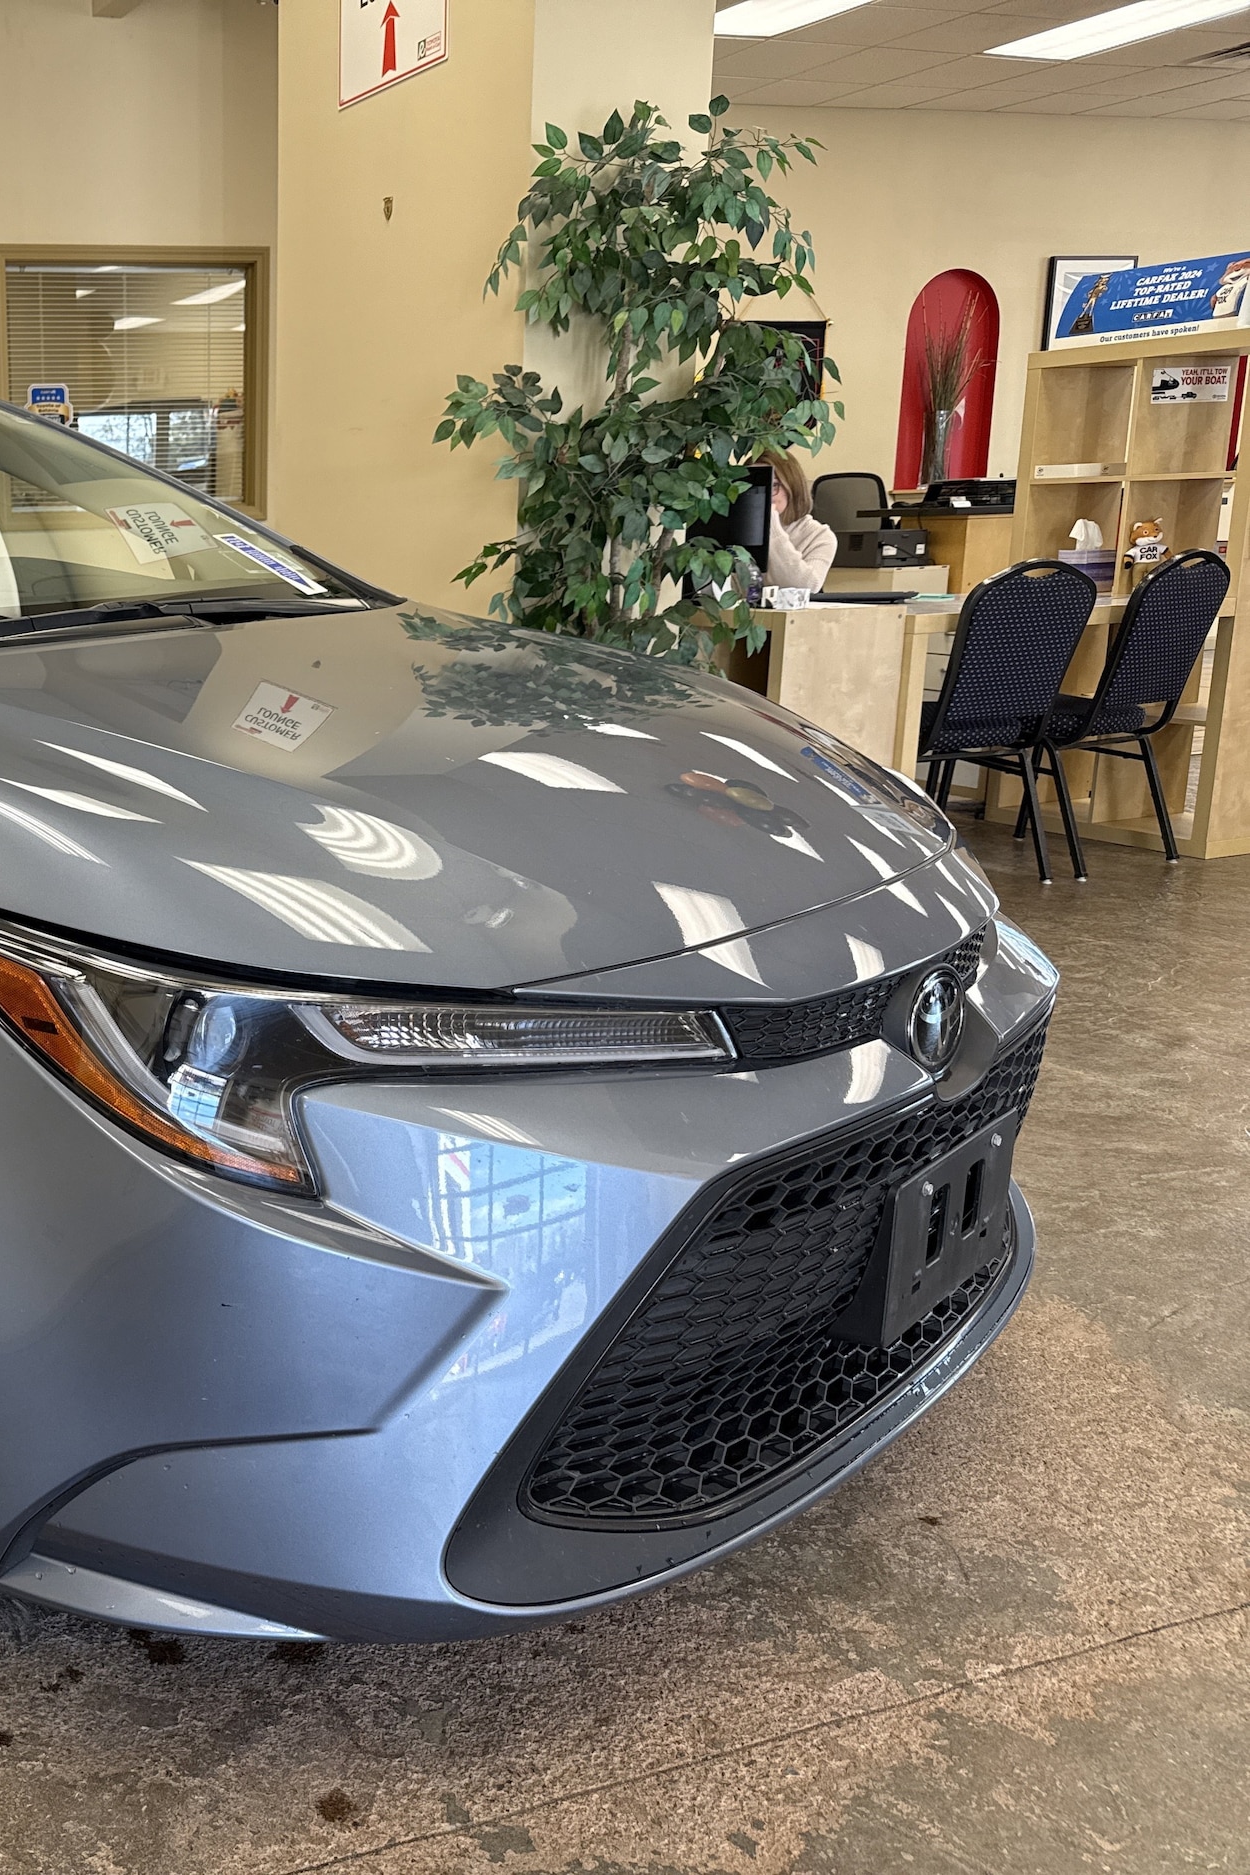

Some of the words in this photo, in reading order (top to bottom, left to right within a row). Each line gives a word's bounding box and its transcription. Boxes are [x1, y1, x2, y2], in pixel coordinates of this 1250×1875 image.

[1136, 273, 1178, 287] CARFAX
[1178, 269, 1203, 281] 2024
[1133, 281, 1192, 297] TOP-RATED
[1110, 295, 1161, 311] LIFETIME
[1162, 289, 1209, 306] DEALER!
[1132, 309, 1174, 322] CARFAX
[1099, 335, 1113, 343] Our
[1114, 331, 1150, 342] customers
[1152, 328, 1168, 338] have
[1170, 325, 1200, 338] spoken!
[1181, 376, 1203, 386] YOUR
[1205, 375, 1227, 385] BOAT.
[1139, 553, 1158, 561] FOX
[1140, 546, 1158, 554] CAR
